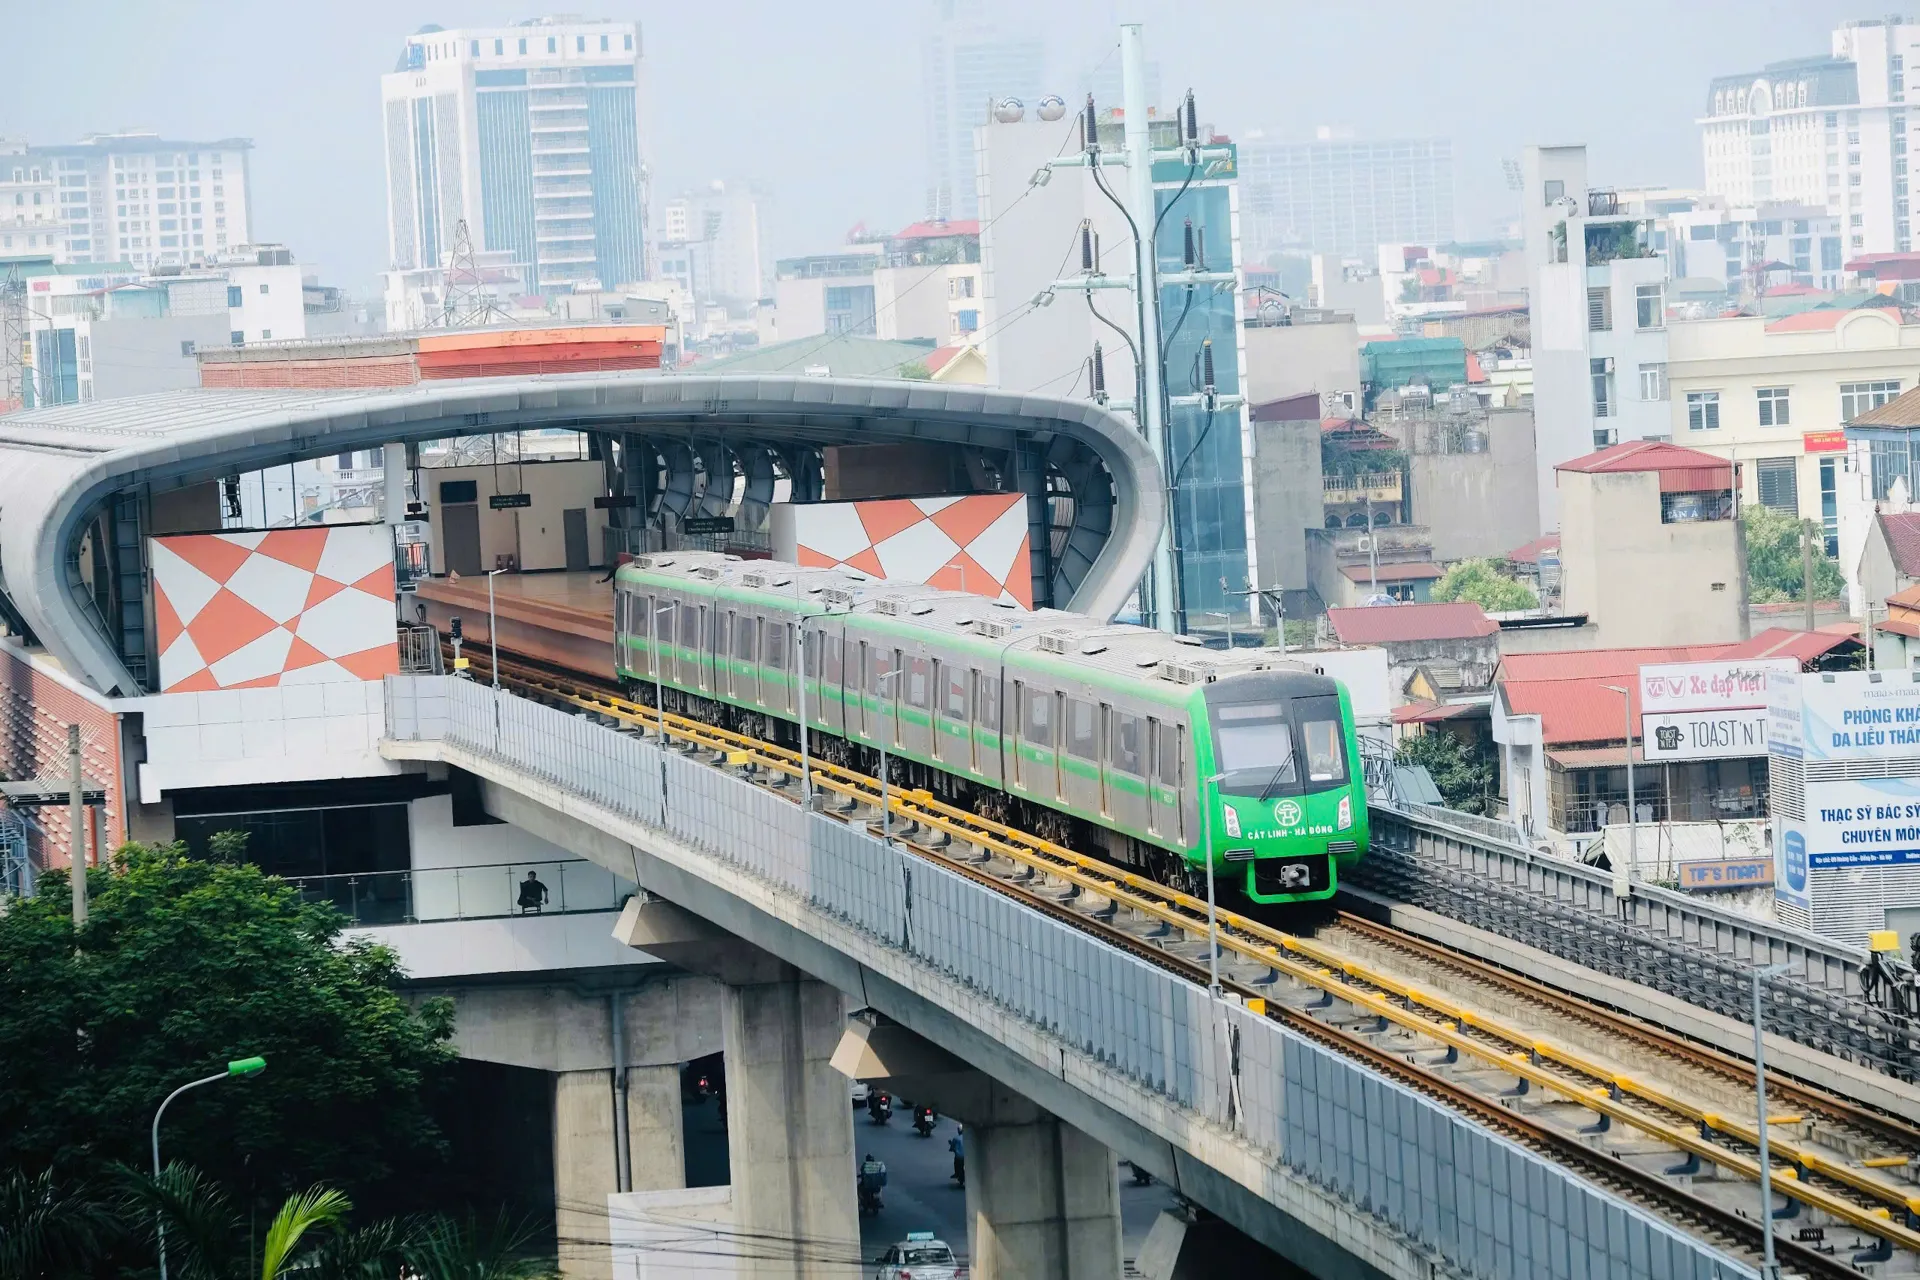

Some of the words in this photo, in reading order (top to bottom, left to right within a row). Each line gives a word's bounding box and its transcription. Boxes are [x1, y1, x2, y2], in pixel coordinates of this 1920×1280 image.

[1690, 675, 1707, 694] Xe
[1844, 706, 1892, 725] PHÒNG
[1660, 729, 1676, 740] TOAST
[1832, 733, 1851, 747] DA
[1820, 808, 1853, 824] THẠC
[1856, 804, 1872, 820] SỸ
[1876, 804, 1901, 819] BÁC
[1247, 830, 1266, 840] CÁT
[1268, 829, 1288, 839] LINH
[1842, 827, 1891, 844] CHUYÊN
